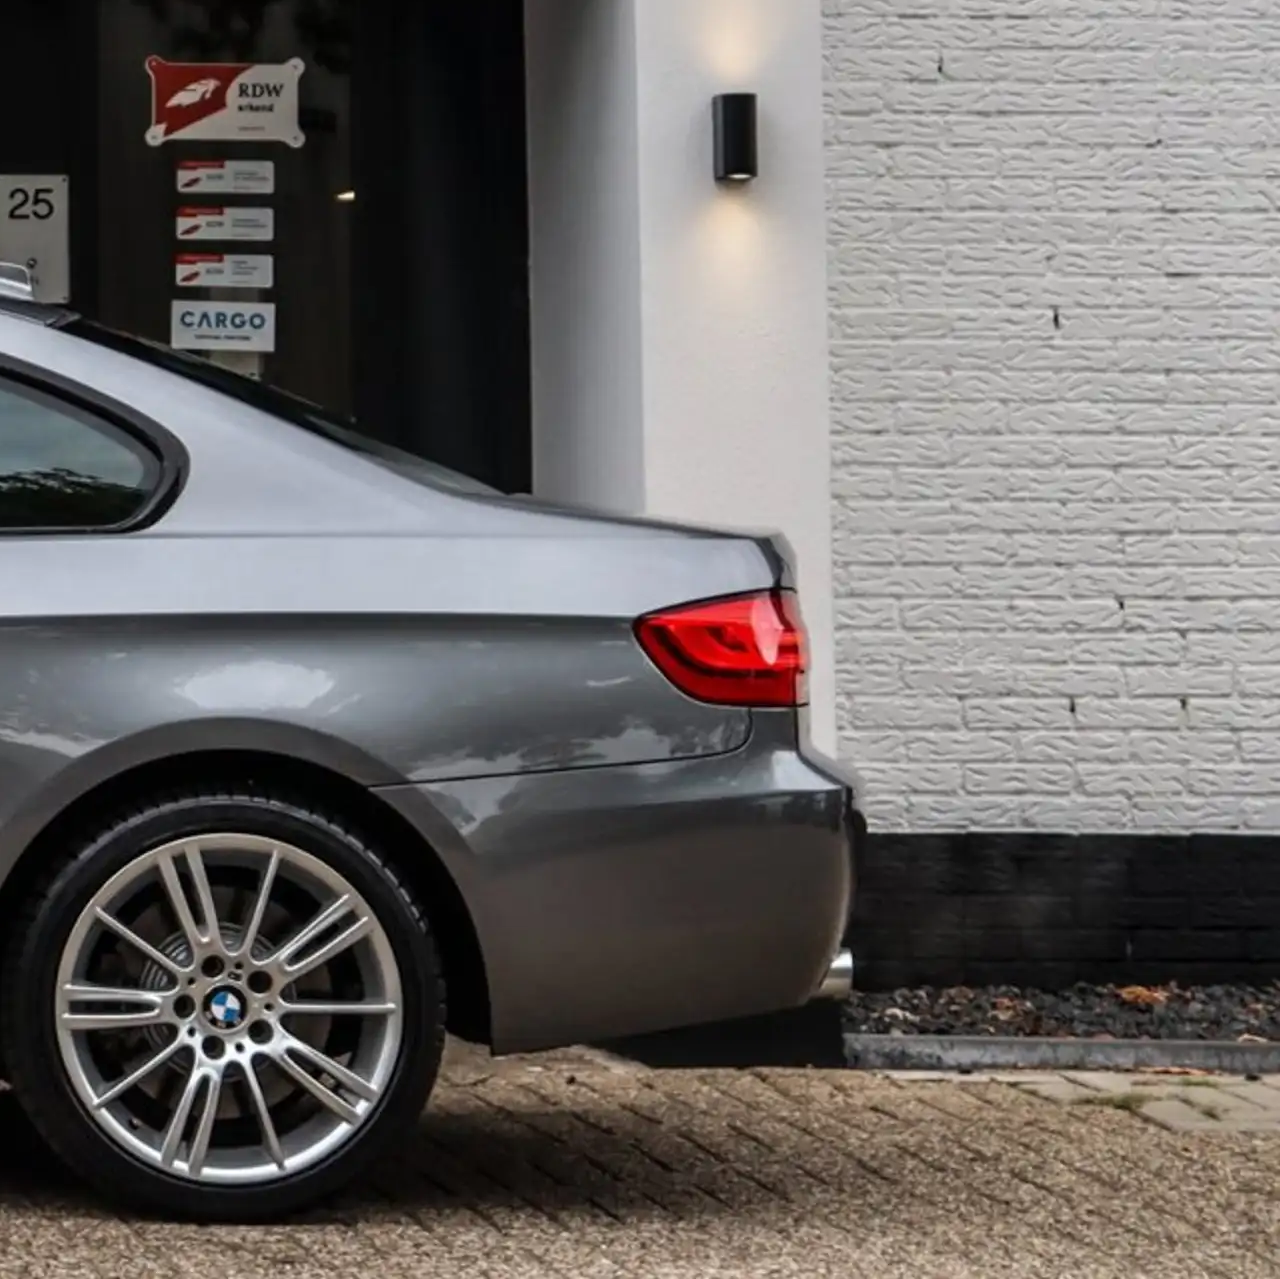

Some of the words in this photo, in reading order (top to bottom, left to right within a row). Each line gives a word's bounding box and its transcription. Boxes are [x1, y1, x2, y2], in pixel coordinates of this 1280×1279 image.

[238, 82, 284, 98] RDW
[8, 187, 54, 220] 25
[180, 310, 266, 329] CARGO
